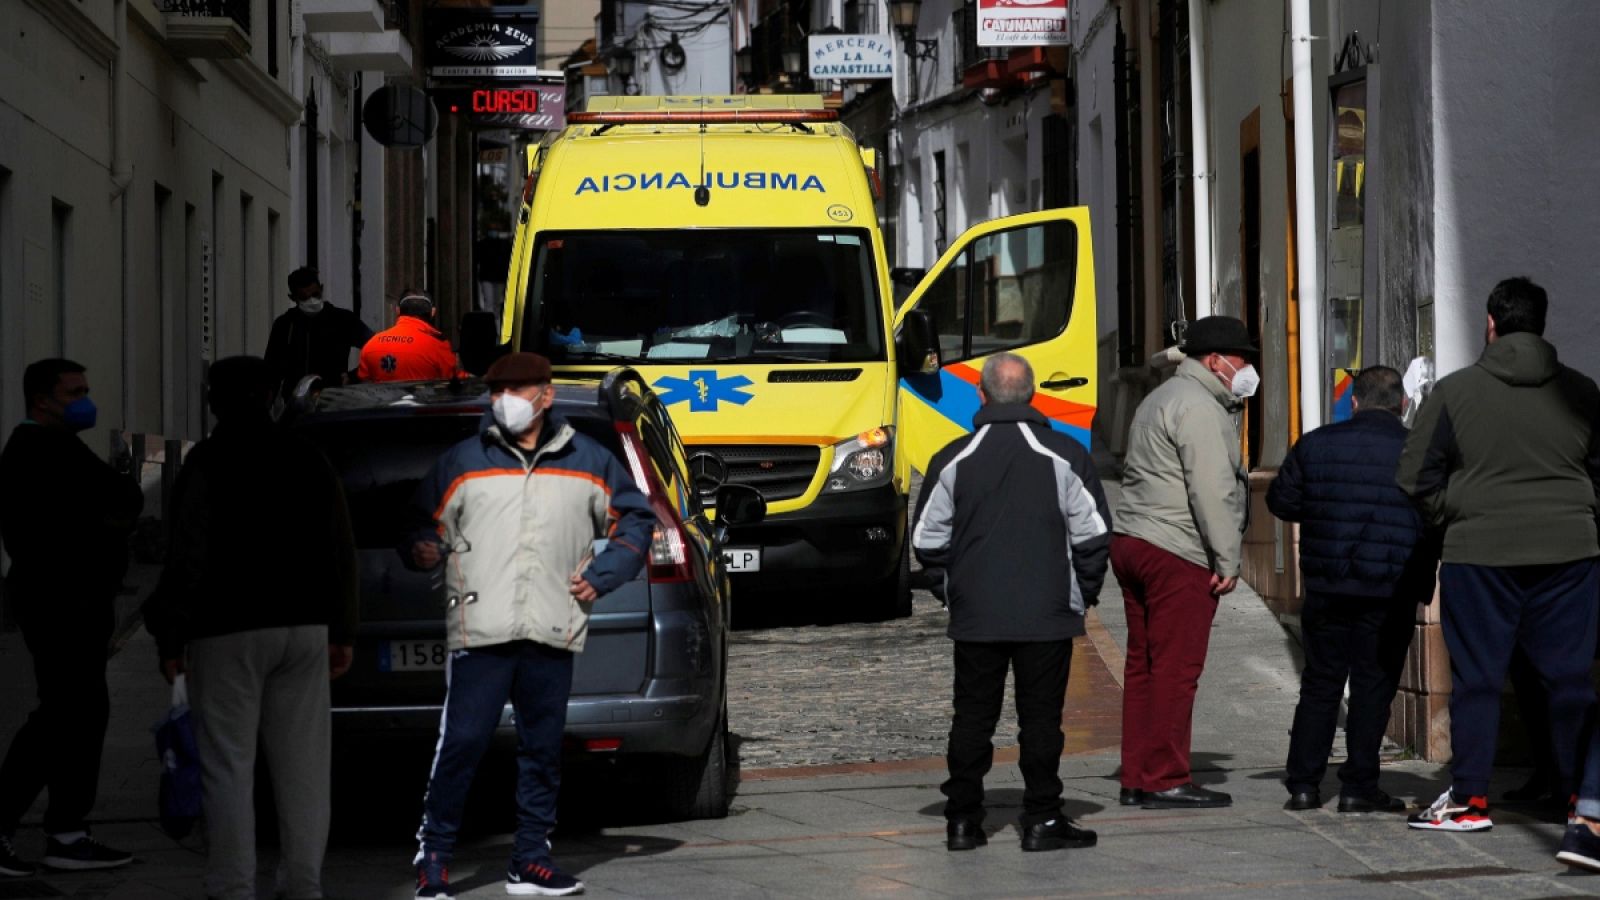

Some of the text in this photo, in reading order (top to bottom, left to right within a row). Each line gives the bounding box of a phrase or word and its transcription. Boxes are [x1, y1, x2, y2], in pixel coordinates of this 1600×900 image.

[435, 23, 534, 48] ACADEMIA ZEUS
[1021, 33, 1029, 41] de
[815, 38, 892, 58] MERCERIA
[844, 52, 863, 61] LA
[814, 64, 892, 74] CANASTILLA
[472, 89, 538, 113] CURSO
[731, 552, 753, 569] LP
[399, 643, 446, 667] 158
